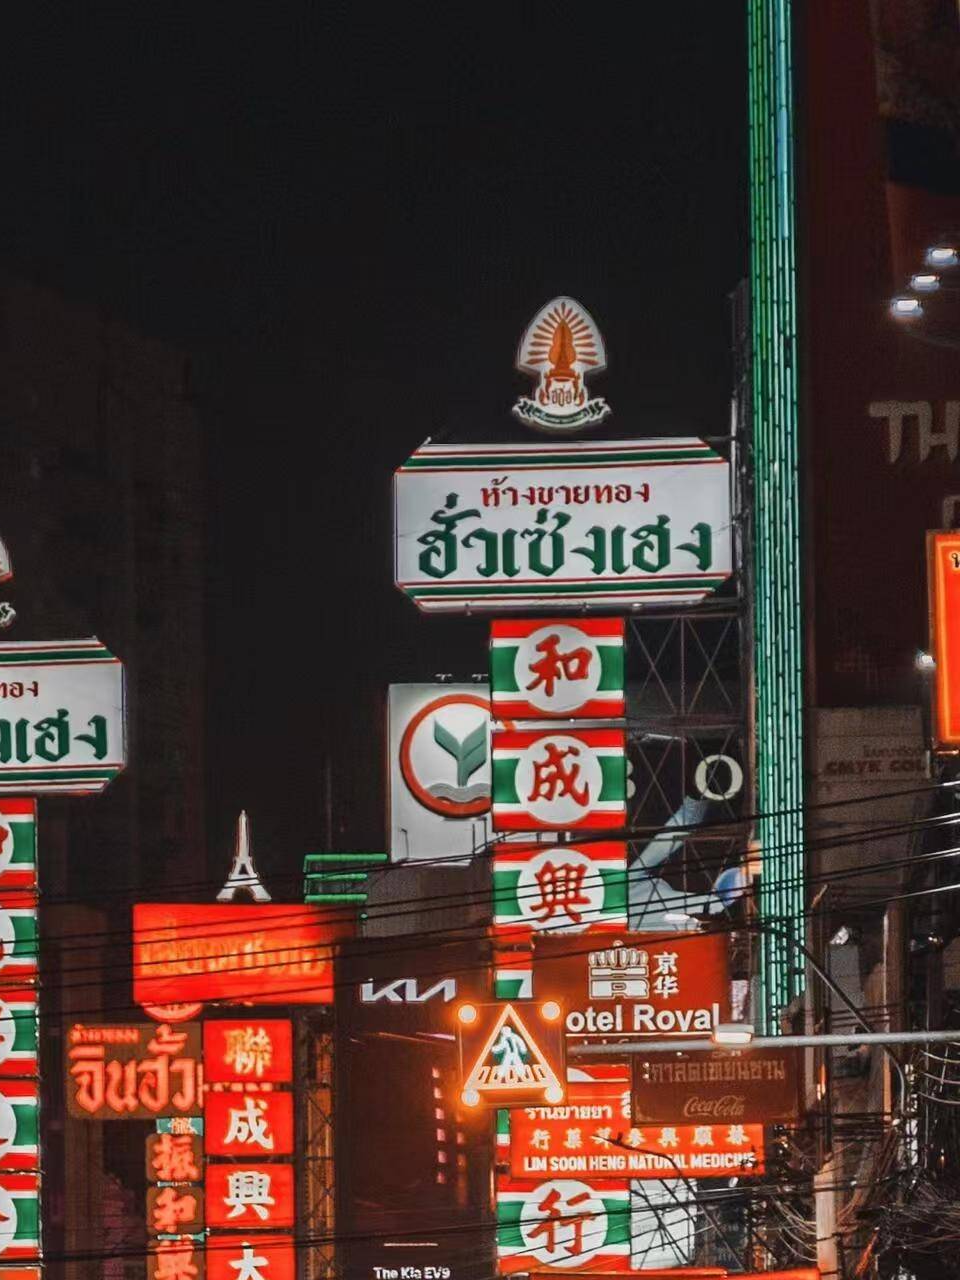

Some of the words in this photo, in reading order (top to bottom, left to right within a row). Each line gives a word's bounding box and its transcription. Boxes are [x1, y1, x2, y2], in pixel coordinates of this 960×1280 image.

[480, 476, 650, 508] ห้างขายทอง
[417, 492, 712, 578] ฮั่วเซ่งเฮง
[566, 1004, 623, 1032] otel
[524, 1106, 612, 1120] รานขายยา
[524, 1155, 547, 1171] LIM
[551, 1155, 587, 1171] SOON
[589, 1155, 625, 1170] HENG
[373, 1266, 398, 1279] The
[401, 1266, 422, 1279] Kia
[424, 1266, 451, 1279] EV9
